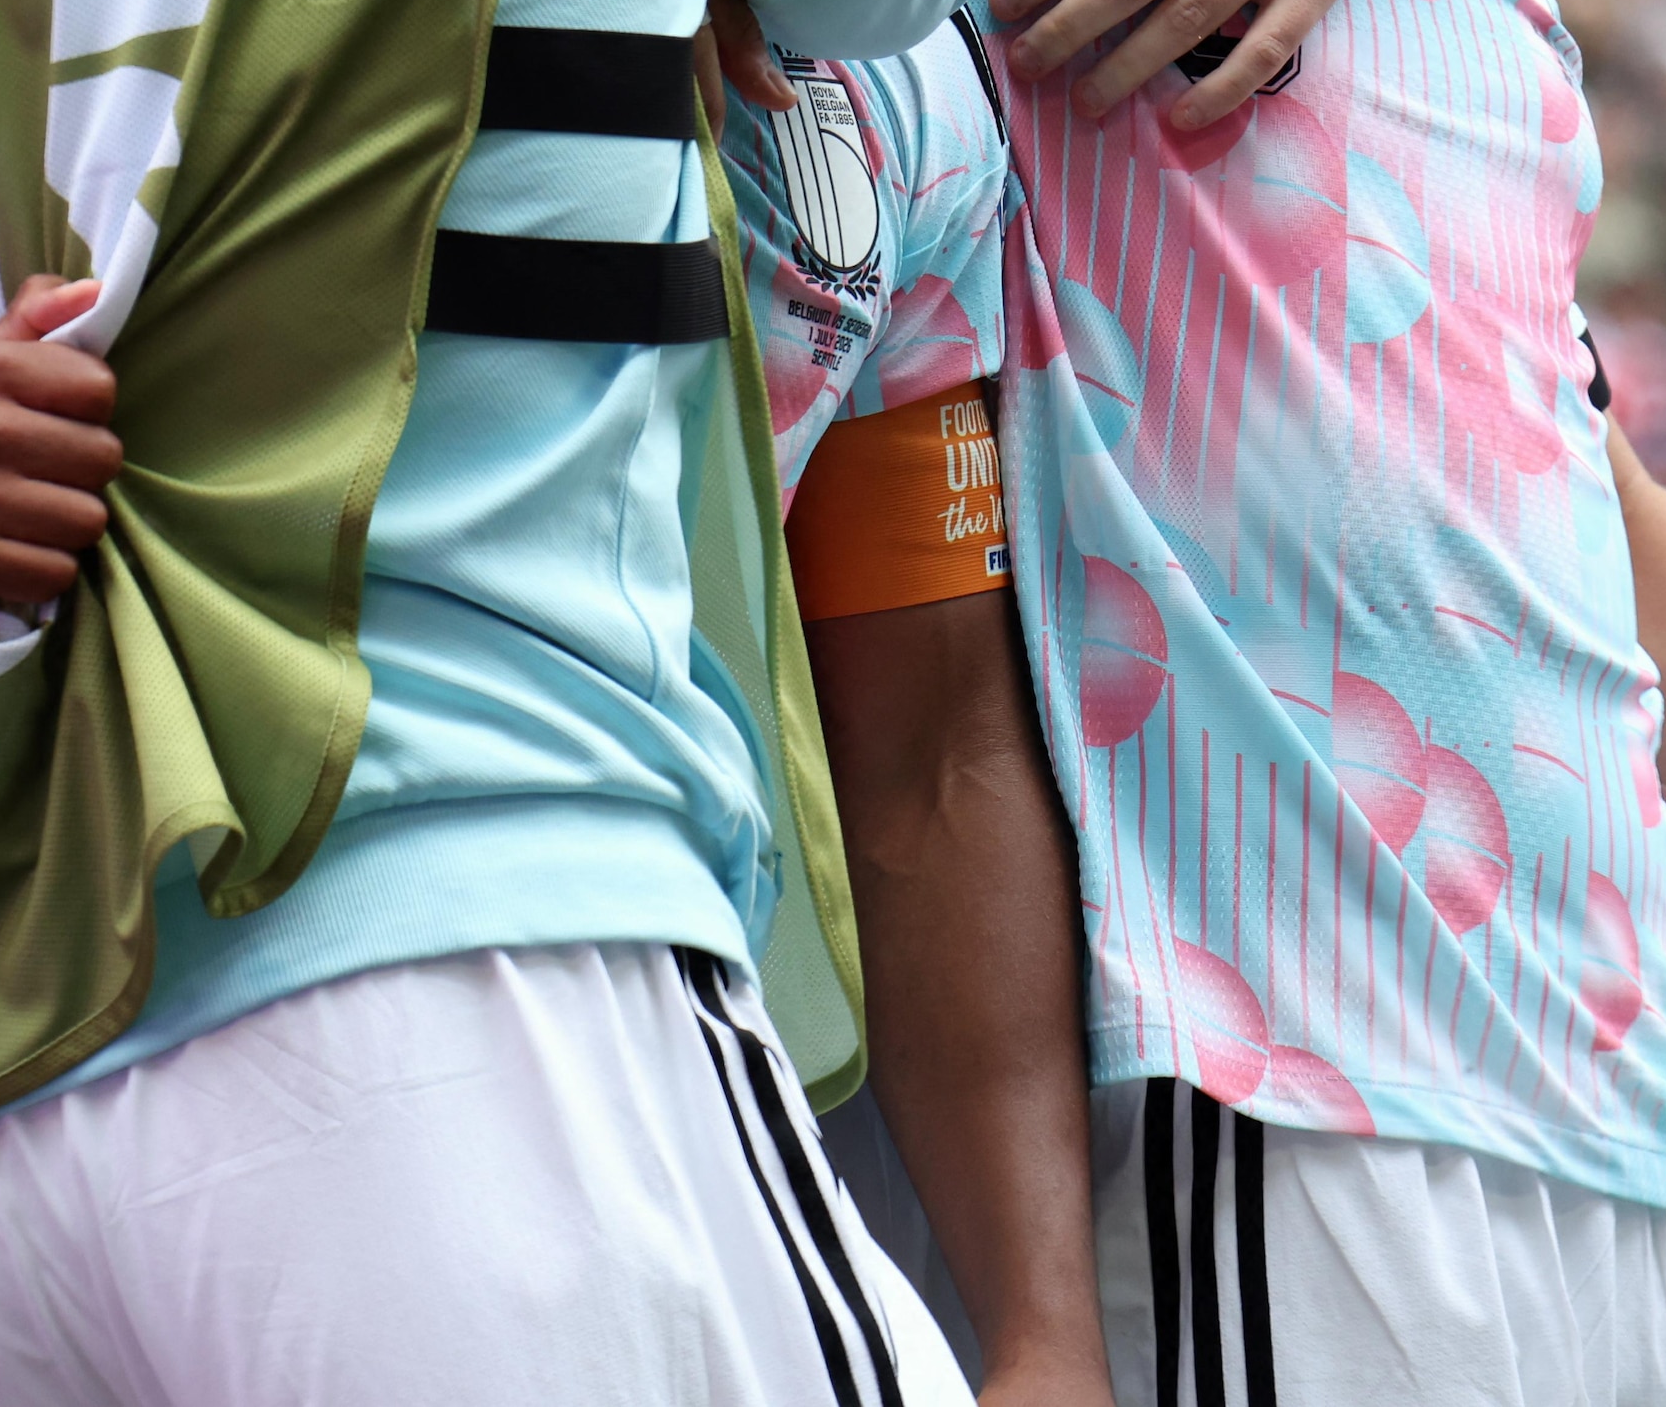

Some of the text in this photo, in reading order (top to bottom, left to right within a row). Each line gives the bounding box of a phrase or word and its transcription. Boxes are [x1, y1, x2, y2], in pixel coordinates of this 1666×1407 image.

[810, 86, 839, 99] ROYAL
[814, 99, 851, 113] BELGIAN
[787, 299, 833, 326] BELGIUM
[831, 313, 847, 330] VS
[808, 326, 853, 354] 1 JULY 2026
[811, 348, 843, 371] SEATTLE
[945, 437, 1001, 492] UNIT
[936, 496, 989, 542] the
[989, 547, 1011, 571] FIF
